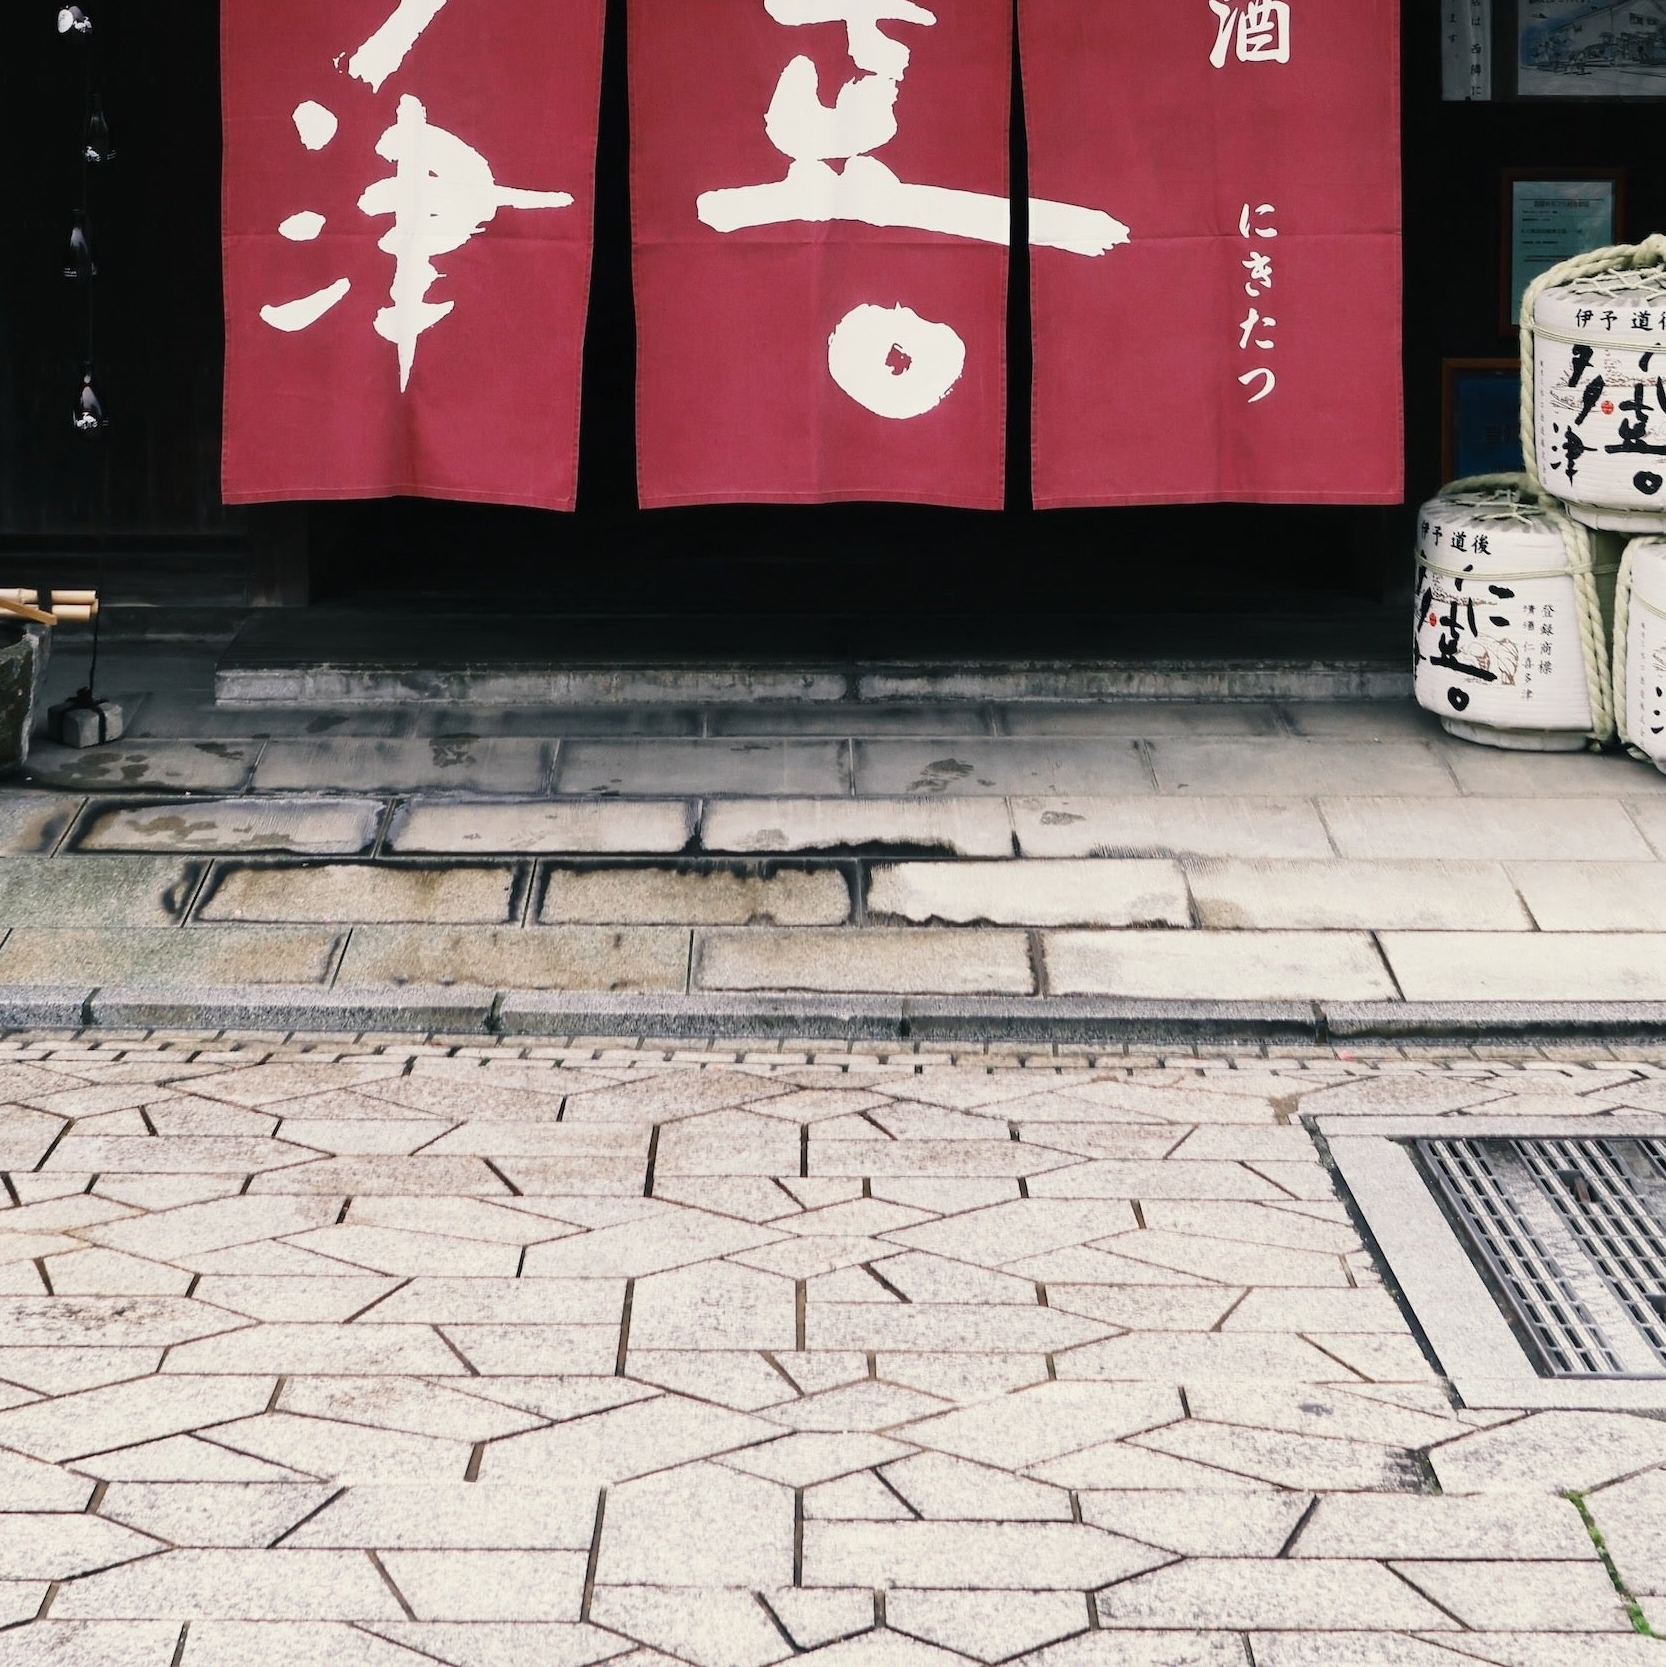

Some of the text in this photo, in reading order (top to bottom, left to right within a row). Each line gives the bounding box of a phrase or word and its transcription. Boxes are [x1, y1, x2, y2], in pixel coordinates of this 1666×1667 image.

[1237, 203, 1278, 404] にきたつ
[1576, 308, 1618, 331] 伊予
[1421, 518, 1493, 556] 伊予 道後
